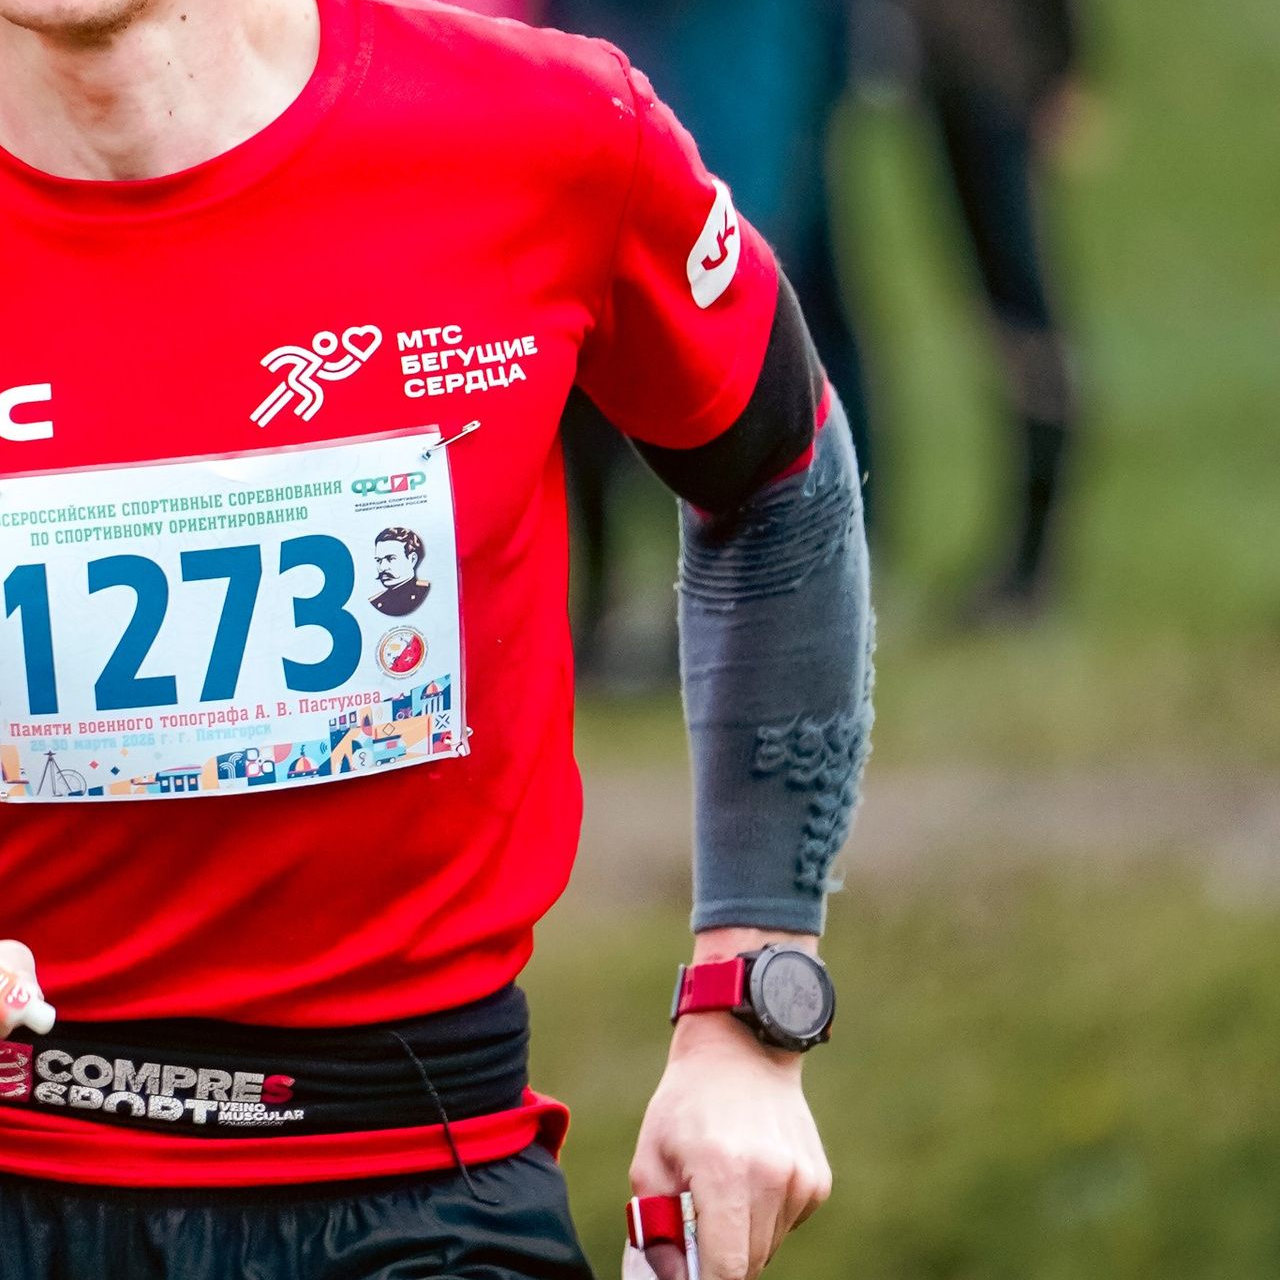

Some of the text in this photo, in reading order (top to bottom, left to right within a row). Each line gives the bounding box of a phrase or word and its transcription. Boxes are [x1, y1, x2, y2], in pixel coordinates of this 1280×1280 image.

[397, 325, 464, 351] МТС
[401, 335, 538, 376] БЕГУЩИЕ
[404, 363, 527, 398] СЕРДЦА
[122, 494, 223, 517] СПОРТИВНЫЕ
[228, 480, 343, 507] СОРЕВНОВАНИЯ
[31, 506, 308, 546] ПО СПОРТИВНОМУ ОРИЕНТИРОВАНИЮ
[3, 534, 363, 715] 1273
[10, 690, 381, 737] Памяти военного топографа А. В. Пастухова
[73, 735, 117, 752] марта
[196, 724, 272, 742] Пятигорск
[218, 1109, 304, 1122] MUSCULAR
[219, 1102, 266, 1112] VEINO
